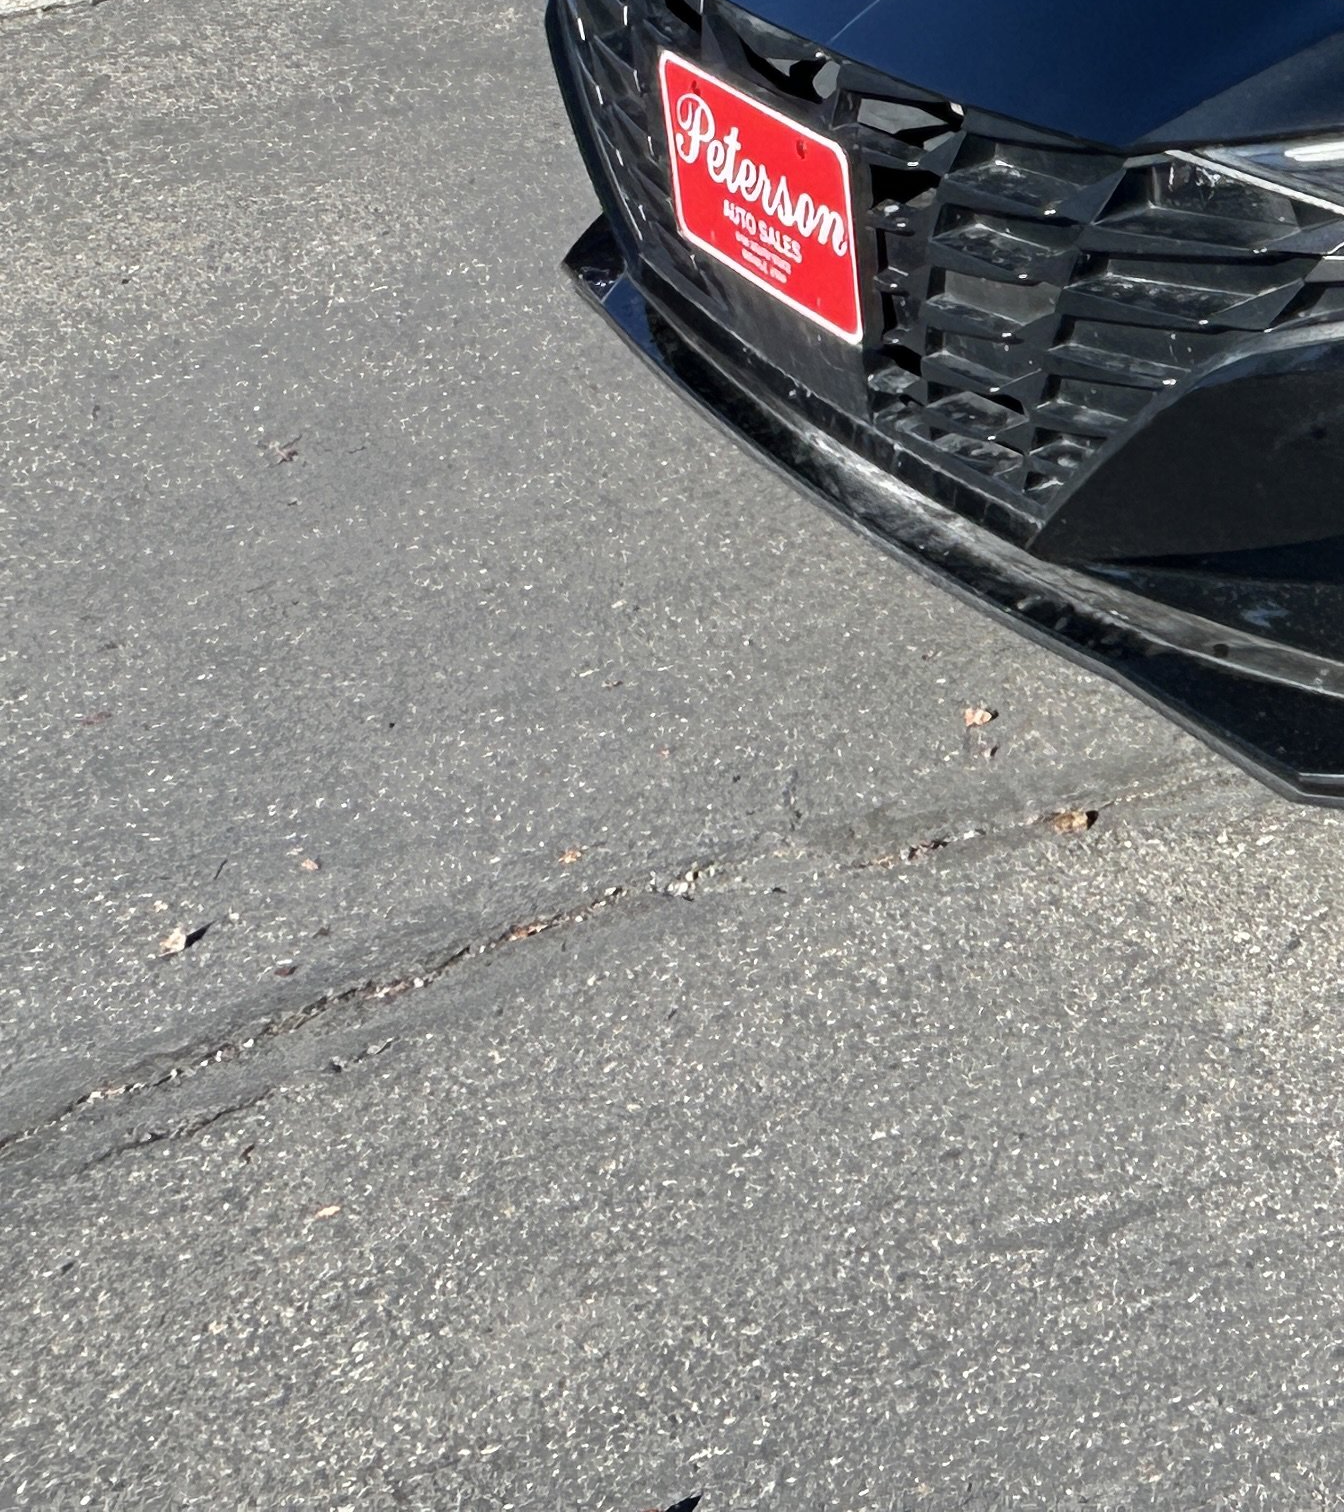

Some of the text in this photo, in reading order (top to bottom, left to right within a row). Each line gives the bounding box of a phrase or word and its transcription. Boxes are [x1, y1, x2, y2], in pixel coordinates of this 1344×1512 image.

[676, 93, 848, 256] Peterson
[724, 199, 757, 235] AUTO
[758, 220, 802, 264] SALES
